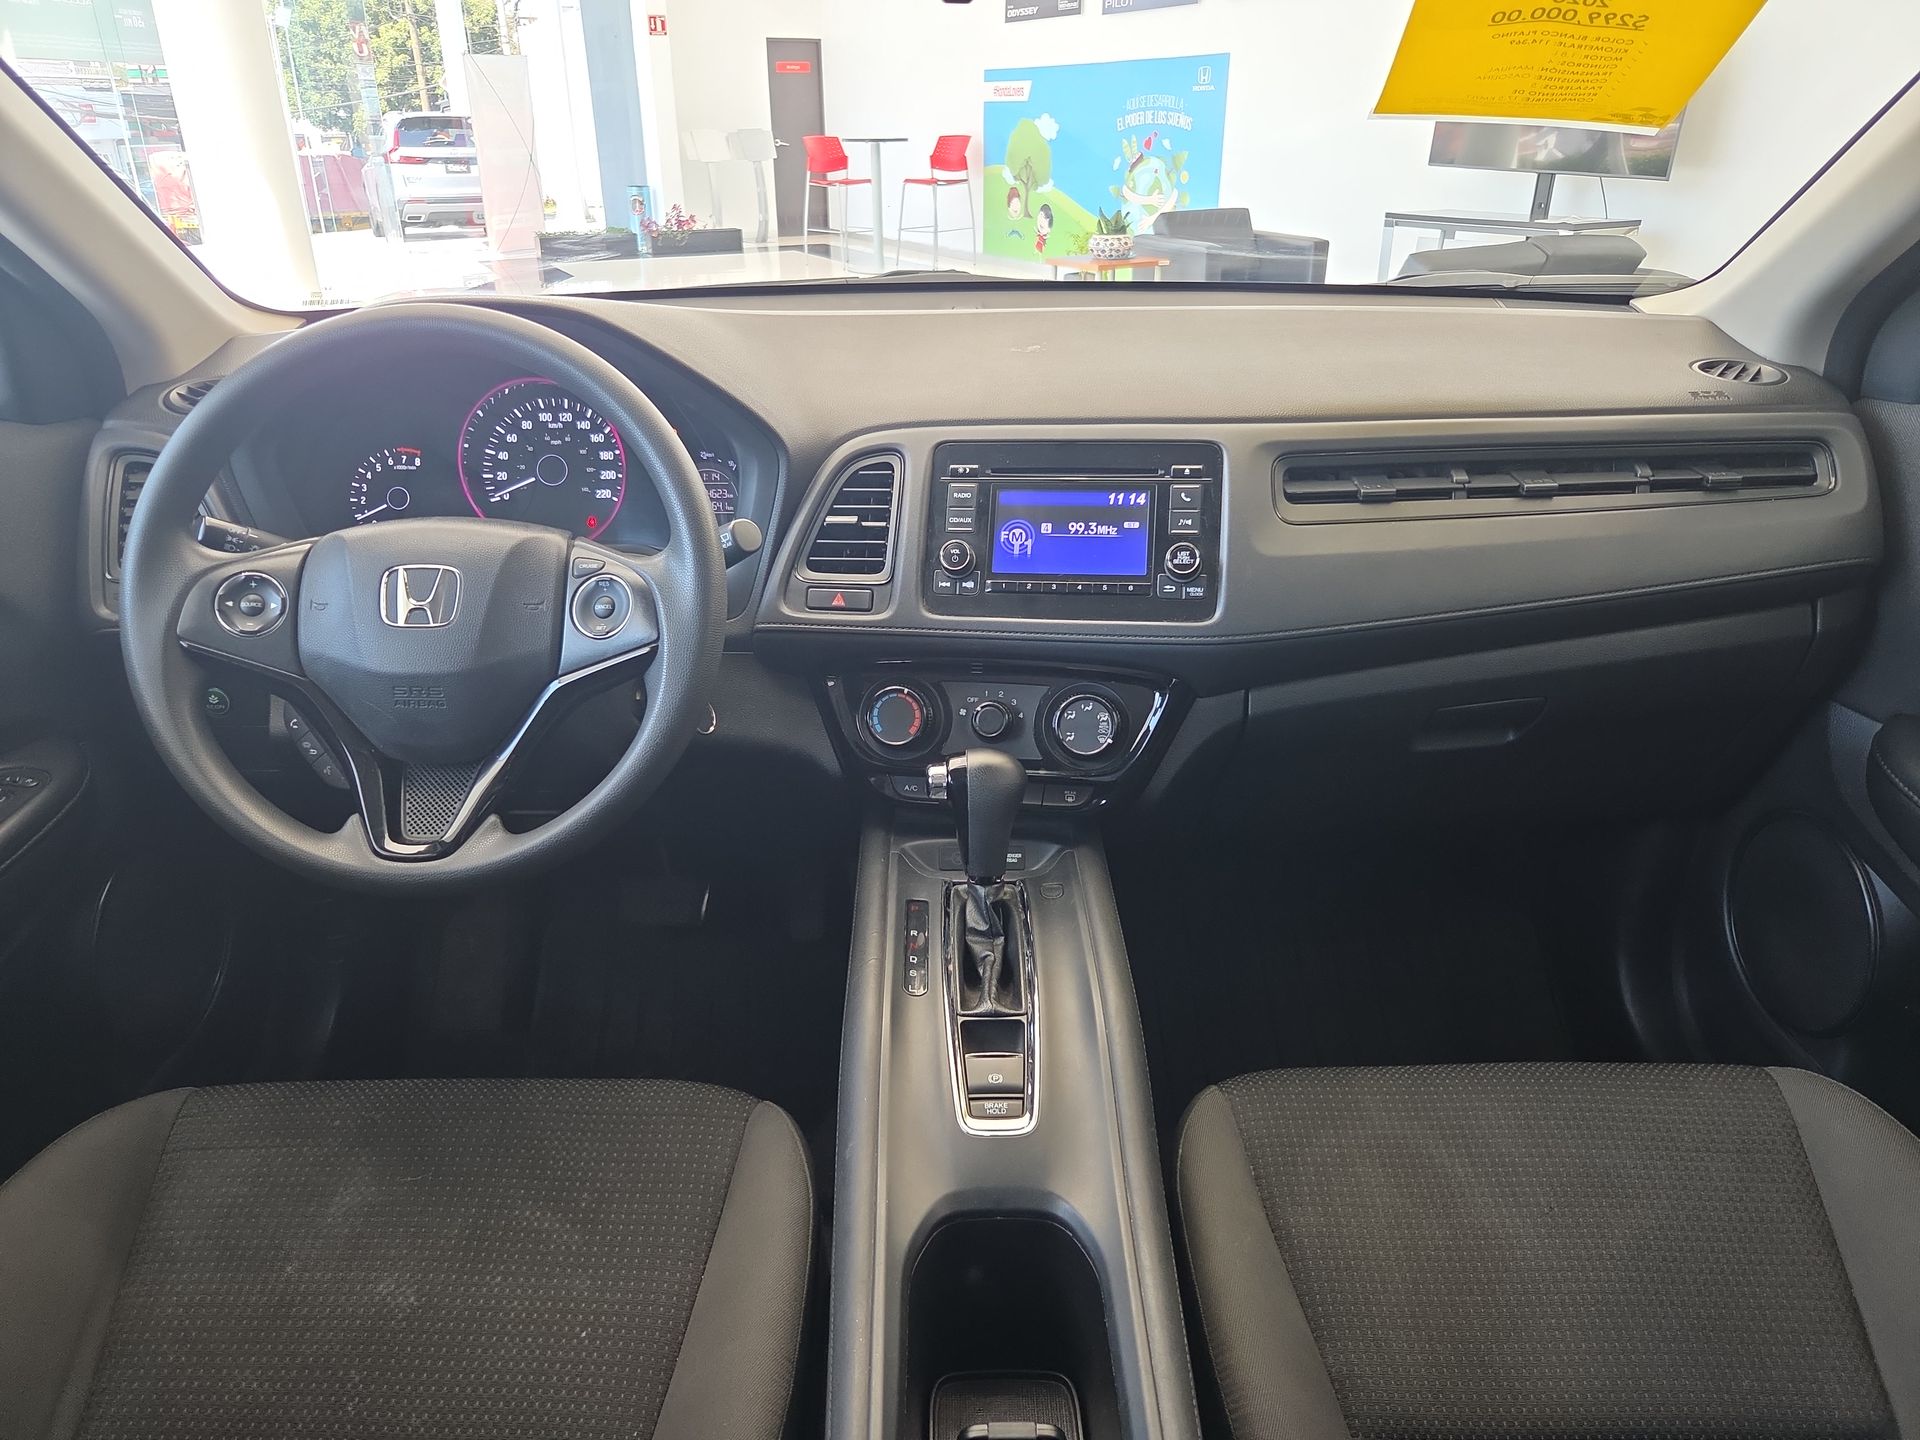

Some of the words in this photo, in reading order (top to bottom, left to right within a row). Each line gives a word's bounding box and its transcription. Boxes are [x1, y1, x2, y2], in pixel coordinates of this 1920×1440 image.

[1007, 6, 1039, 17] ODYSSEY
[1117, 118, 1125, 131] EL
[1125, 111, 1145, 129] PODER
[1145, 110, 1154, 124] DE
[1154, 110, 1167, 125] LOS
[538, 413, 552, 422] 100
[558, 413, 573, 422] 120
[521, 421, 532, 430] 80
[548, 422, 563, 430] km/h
[577, 421, 591, 430] 140
[506, 434, 518, 443] 60
[590, 434, 604, 443] 160
[401, 455, 407, 464] 7
[497, 452, 509, 461] 40
[600, 451, 614, 461] 180
[388, 456, 394, 466] 6
[414, 457, 421, 467] 8
[375, 463, 382, 472] 5
[366, 471, 372, 480] 4
[496, 471, 508, 481] 20
[600, 471, 616, 480] 200
[361, 483, 367, 492] 3
[595, 489, 611, 499] 220
[360, 496, 366, 505] 2
[393, 686, 444, 697] SRS
[1011, 698, 1017, 706] 3
[903, 784, 918, 792] A/C
[910, 929, 918, 937] R
[909, 955, 918, 963] D
[909, 969, 917, 977] S
